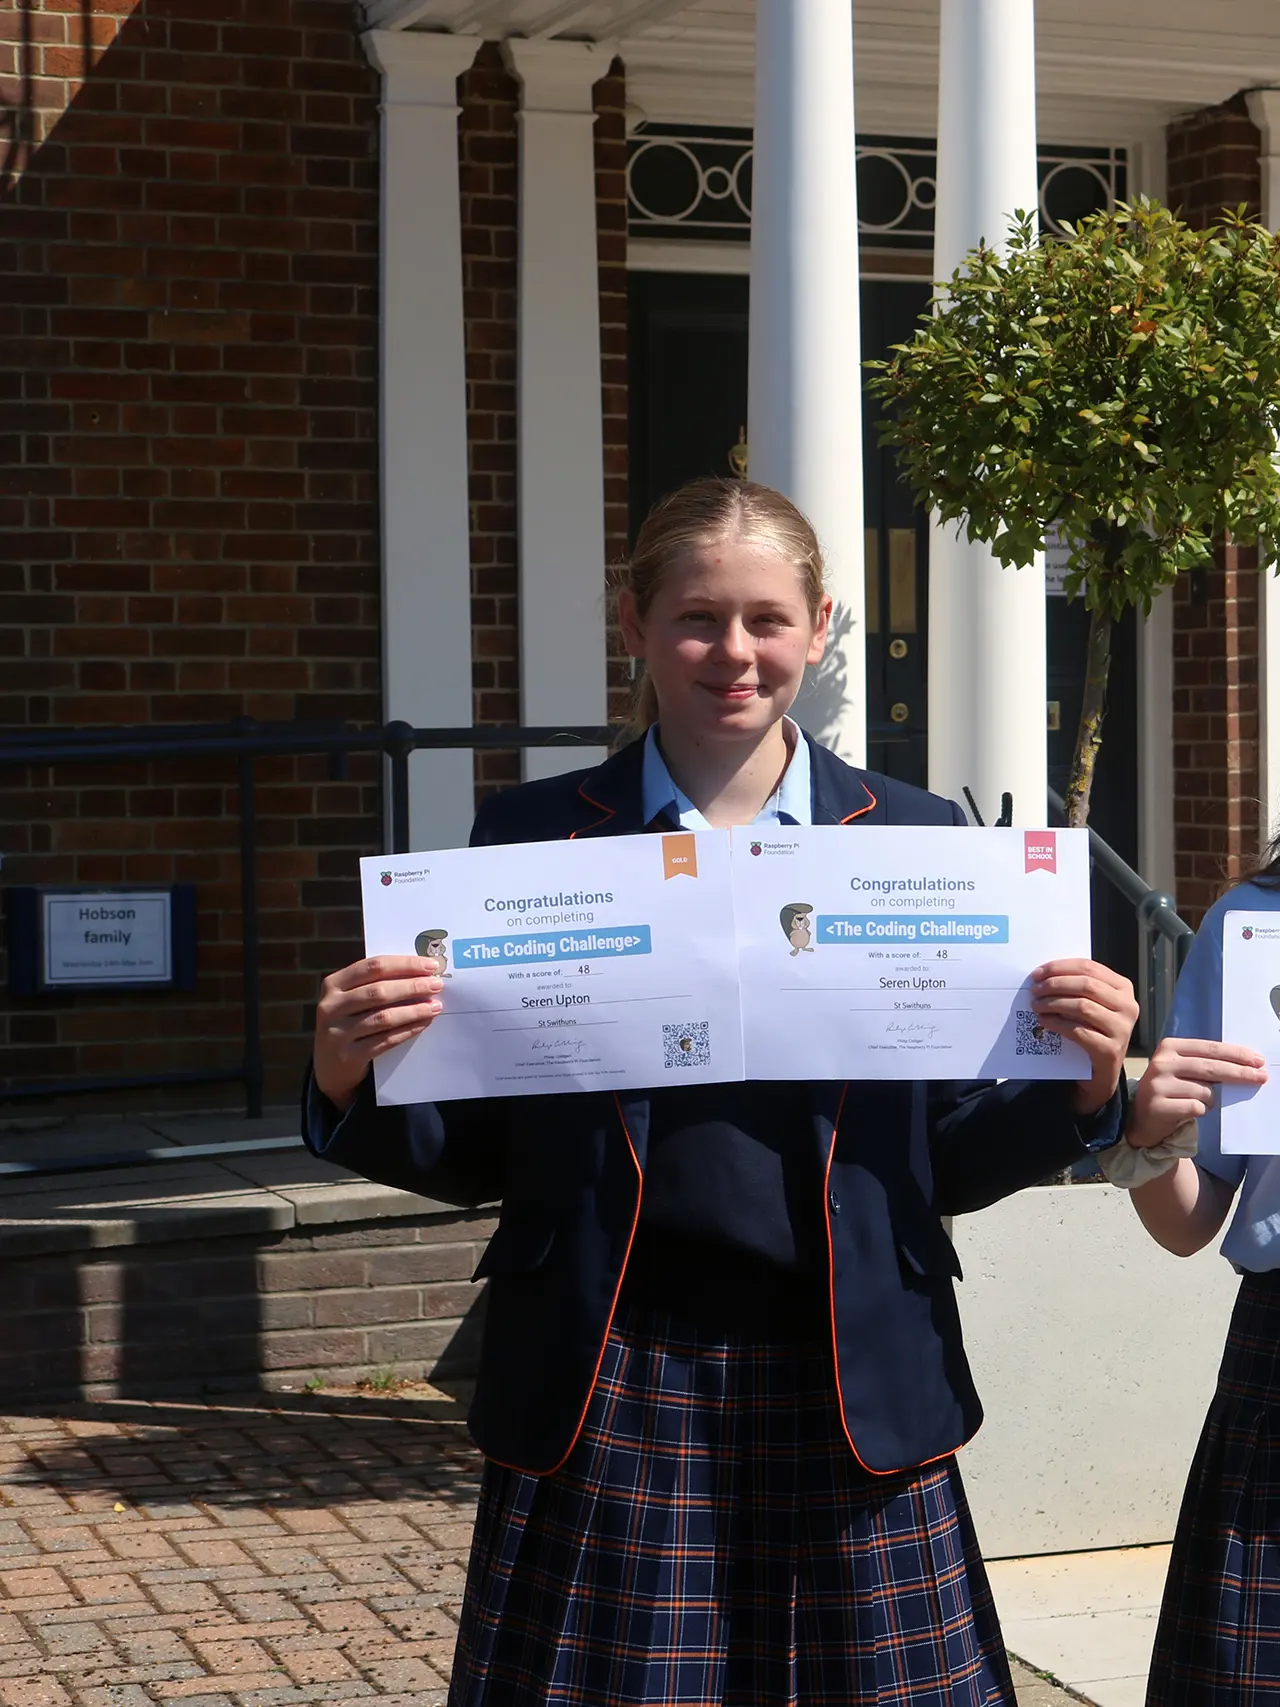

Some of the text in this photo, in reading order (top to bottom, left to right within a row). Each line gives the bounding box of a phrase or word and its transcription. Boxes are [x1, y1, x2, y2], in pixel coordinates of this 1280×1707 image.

[850, 877, 975, 894] Congratulations
[484, 891, 614, 913] Congratulations
[871, 896, 955, 909] on completing
[79, 907, 136, 921] Hobson
[506, 911, 594, 927] on completing
[826, 920, 999, 939] <The Coding Challenge>
[84, 930, 131, 946] family
[462, 935, 641, 960] <The Coding Challenge>
[936, 949, 948, 959] 48
[508, 971, 525, 980] With
[578, 965, 590, 975] 48
[537, 983, 563, 991] awarded
[879, 977, 946, 991] Seren Upton
[521, 994, 590, 1008] Seren Upton
[538, 1018, 577, 1028] St Swithuns
